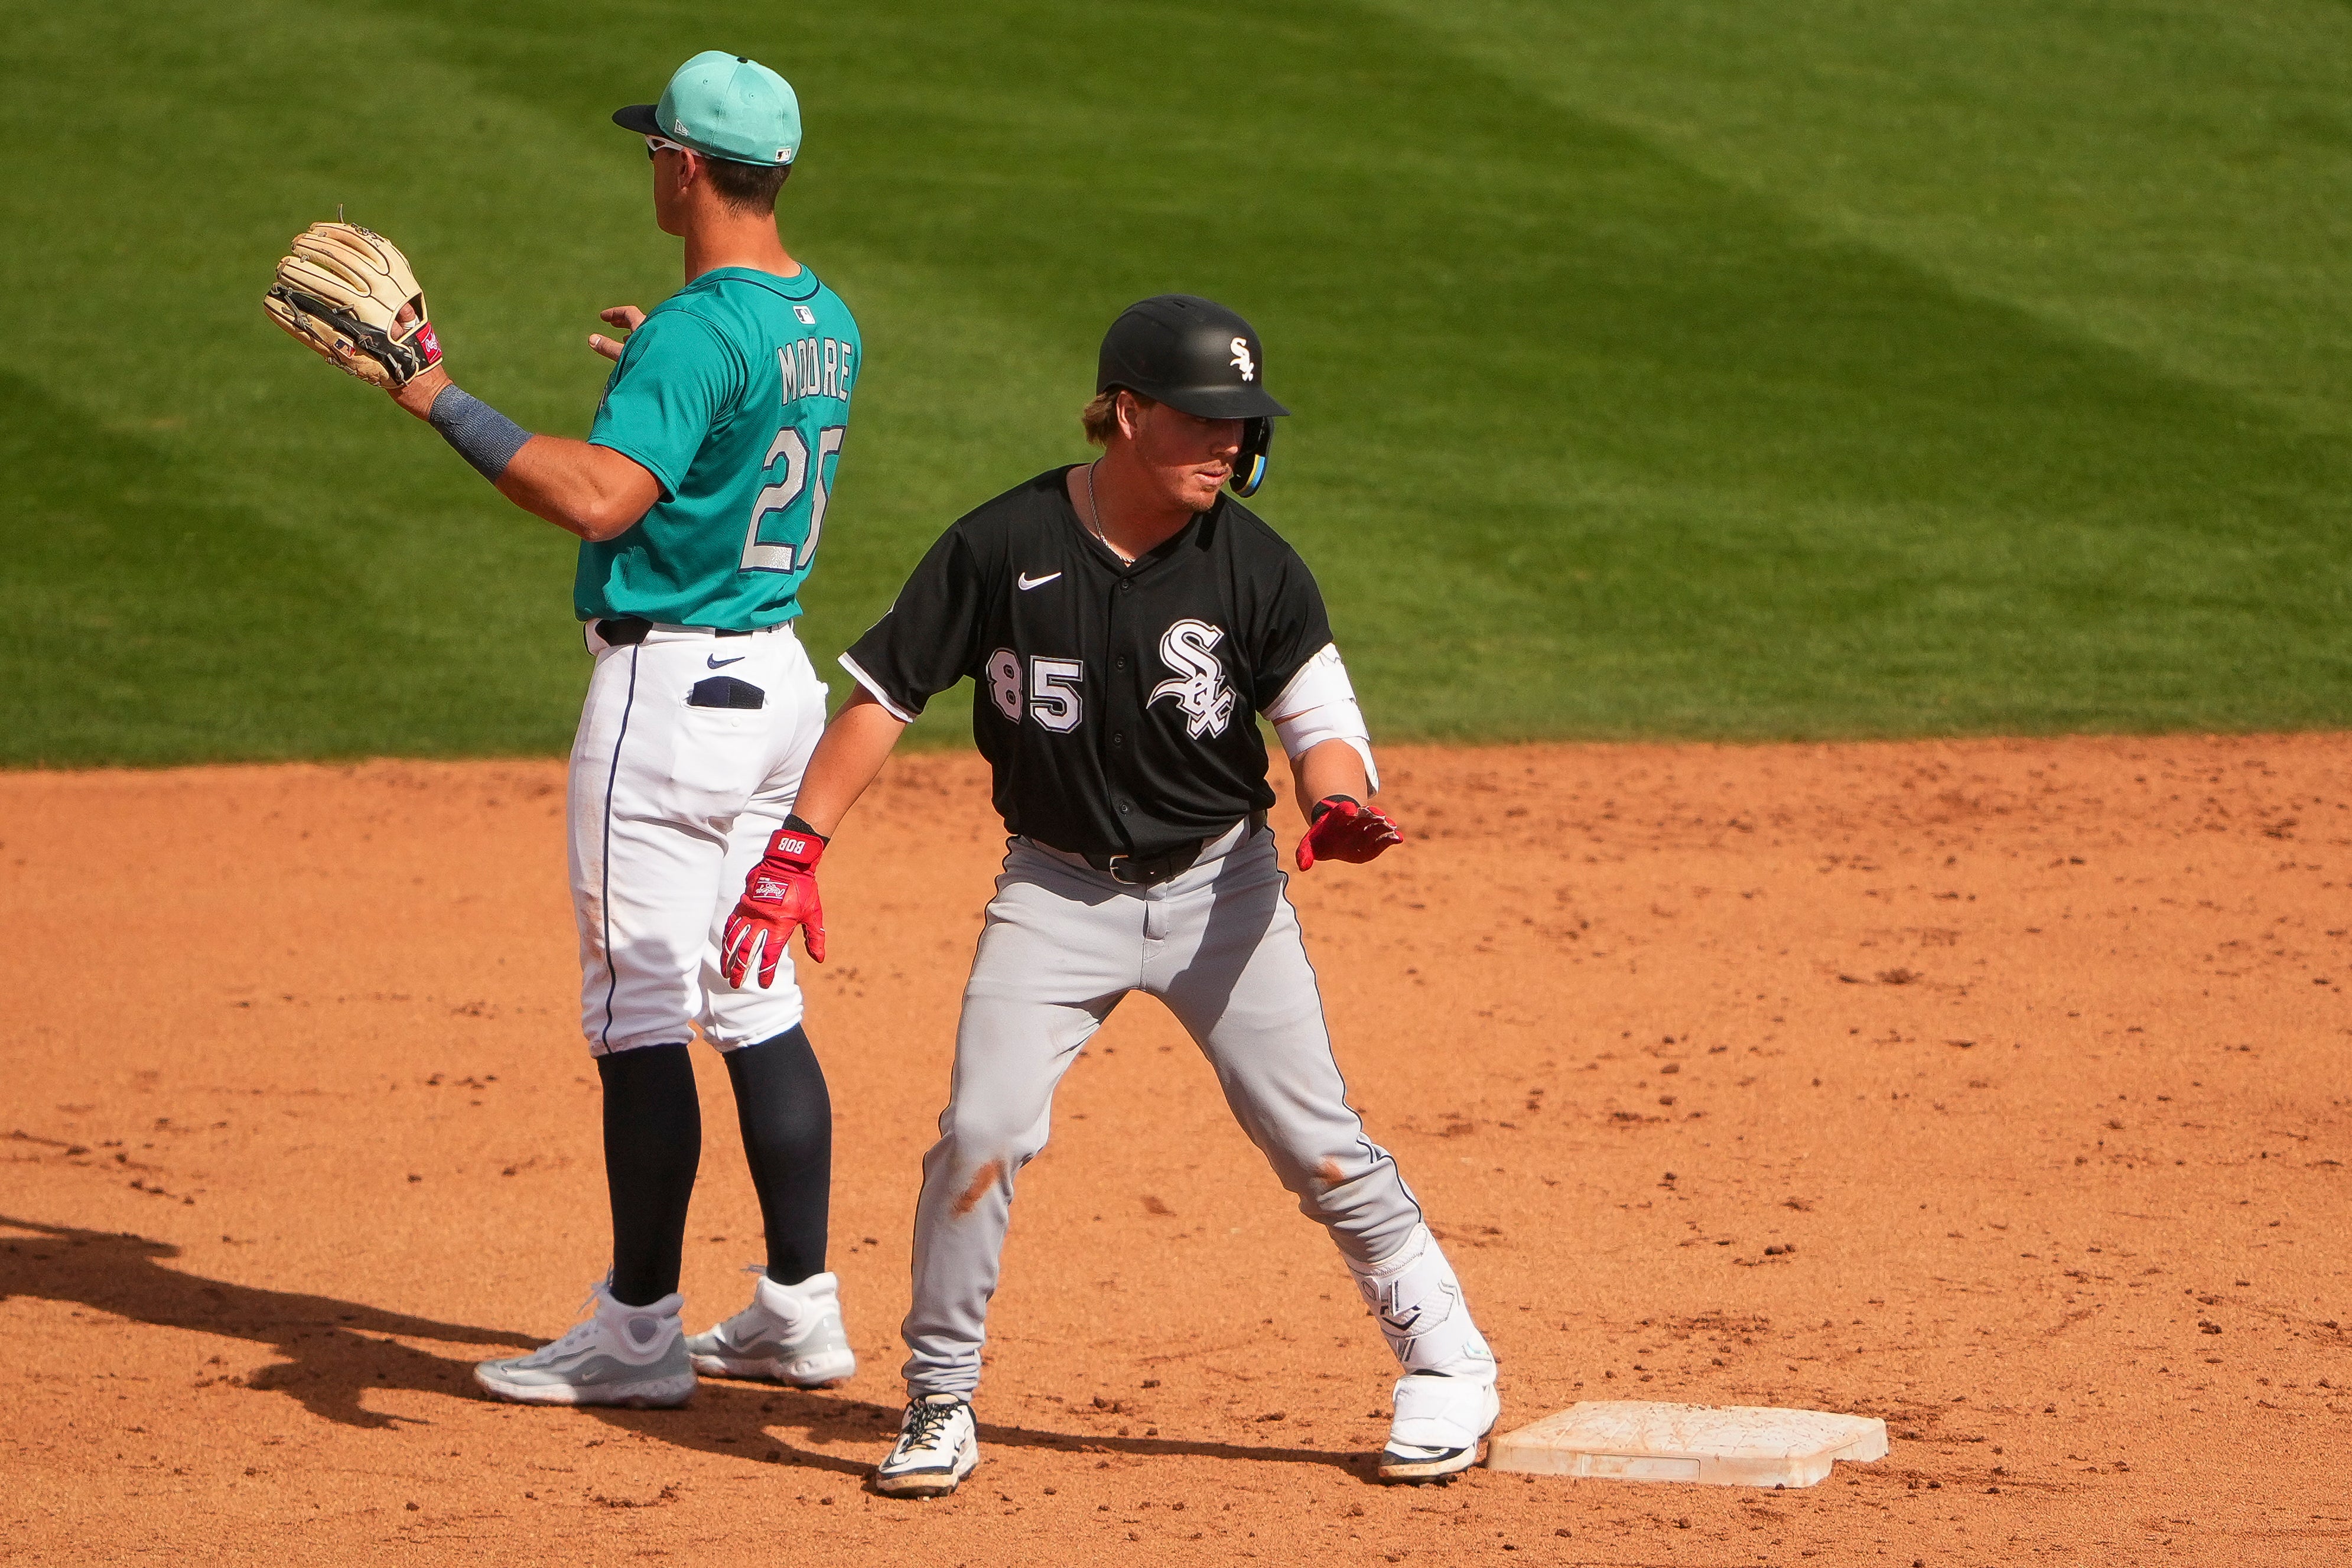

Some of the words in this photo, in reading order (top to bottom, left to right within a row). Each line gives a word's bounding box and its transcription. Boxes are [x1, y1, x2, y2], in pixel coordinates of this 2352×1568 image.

[777, 337, 852, 406] MOORE
[738, 426, 847, 574] 25
[985, 648, 1084, 734] 85
